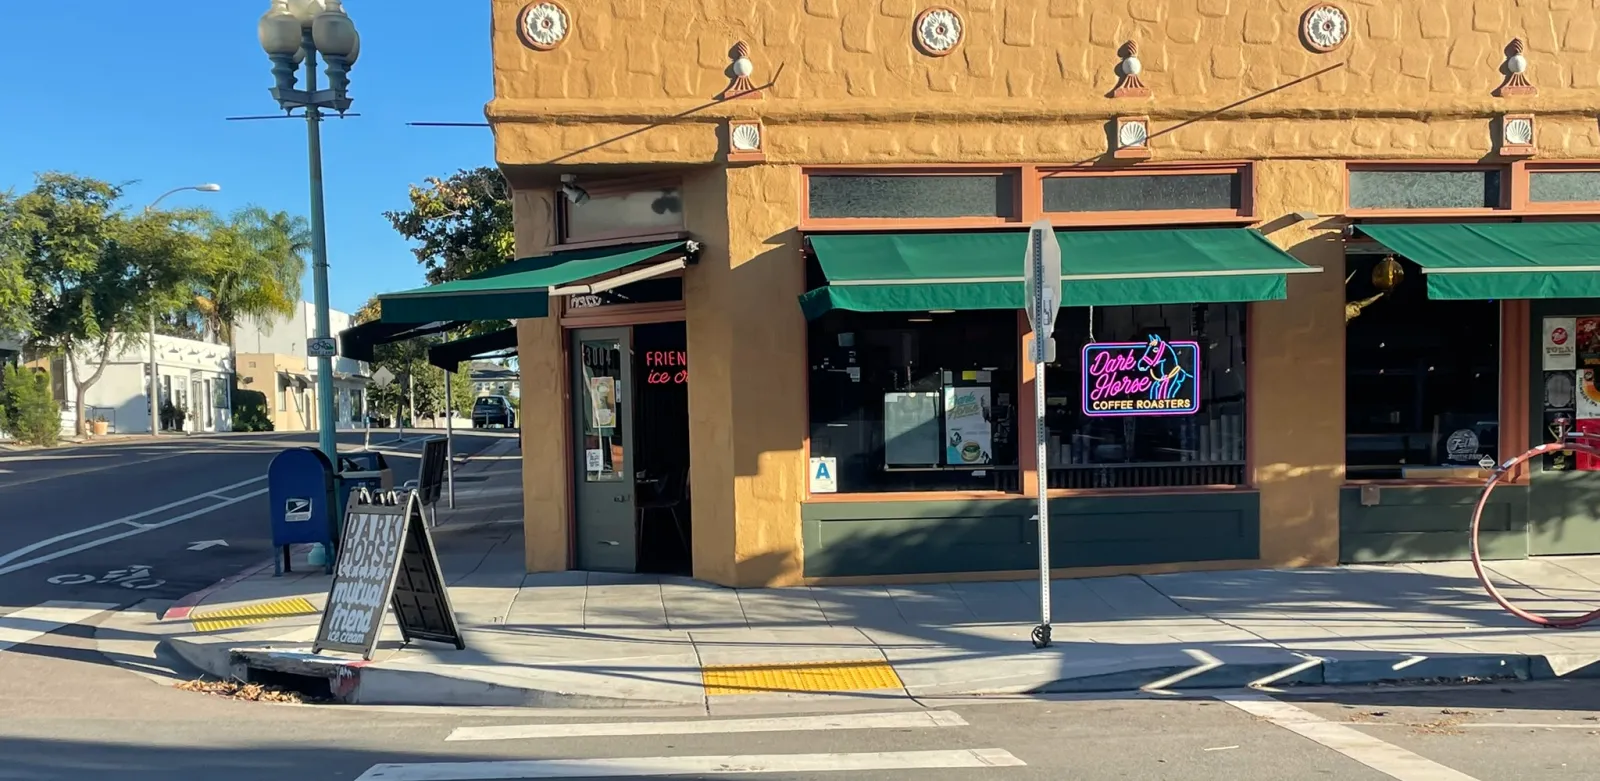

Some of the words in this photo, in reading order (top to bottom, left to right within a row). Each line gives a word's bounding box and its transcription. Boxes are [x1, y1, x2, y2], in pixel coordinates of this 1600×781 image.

[586, 347, 611, 366] 3004
[1090, 349, 1137, 376] Dark
[648, 369, 671, 384] ice
[1090, 372, 1152, 401] Horse
[1093, 400, 1133, 410] COFFEE
[1136, 398, 1191, 409] ROASTERS
[815, 462, 831, 480] A
[347, 513, 402, 544] DARK
[340, 539, 397, 570] HORSE
[331, 579, 386, 609] mutual
[329, 602, 375, 634] friend
[327, 630, 339, 643] ice
[340, 632, 365, 644] cream
